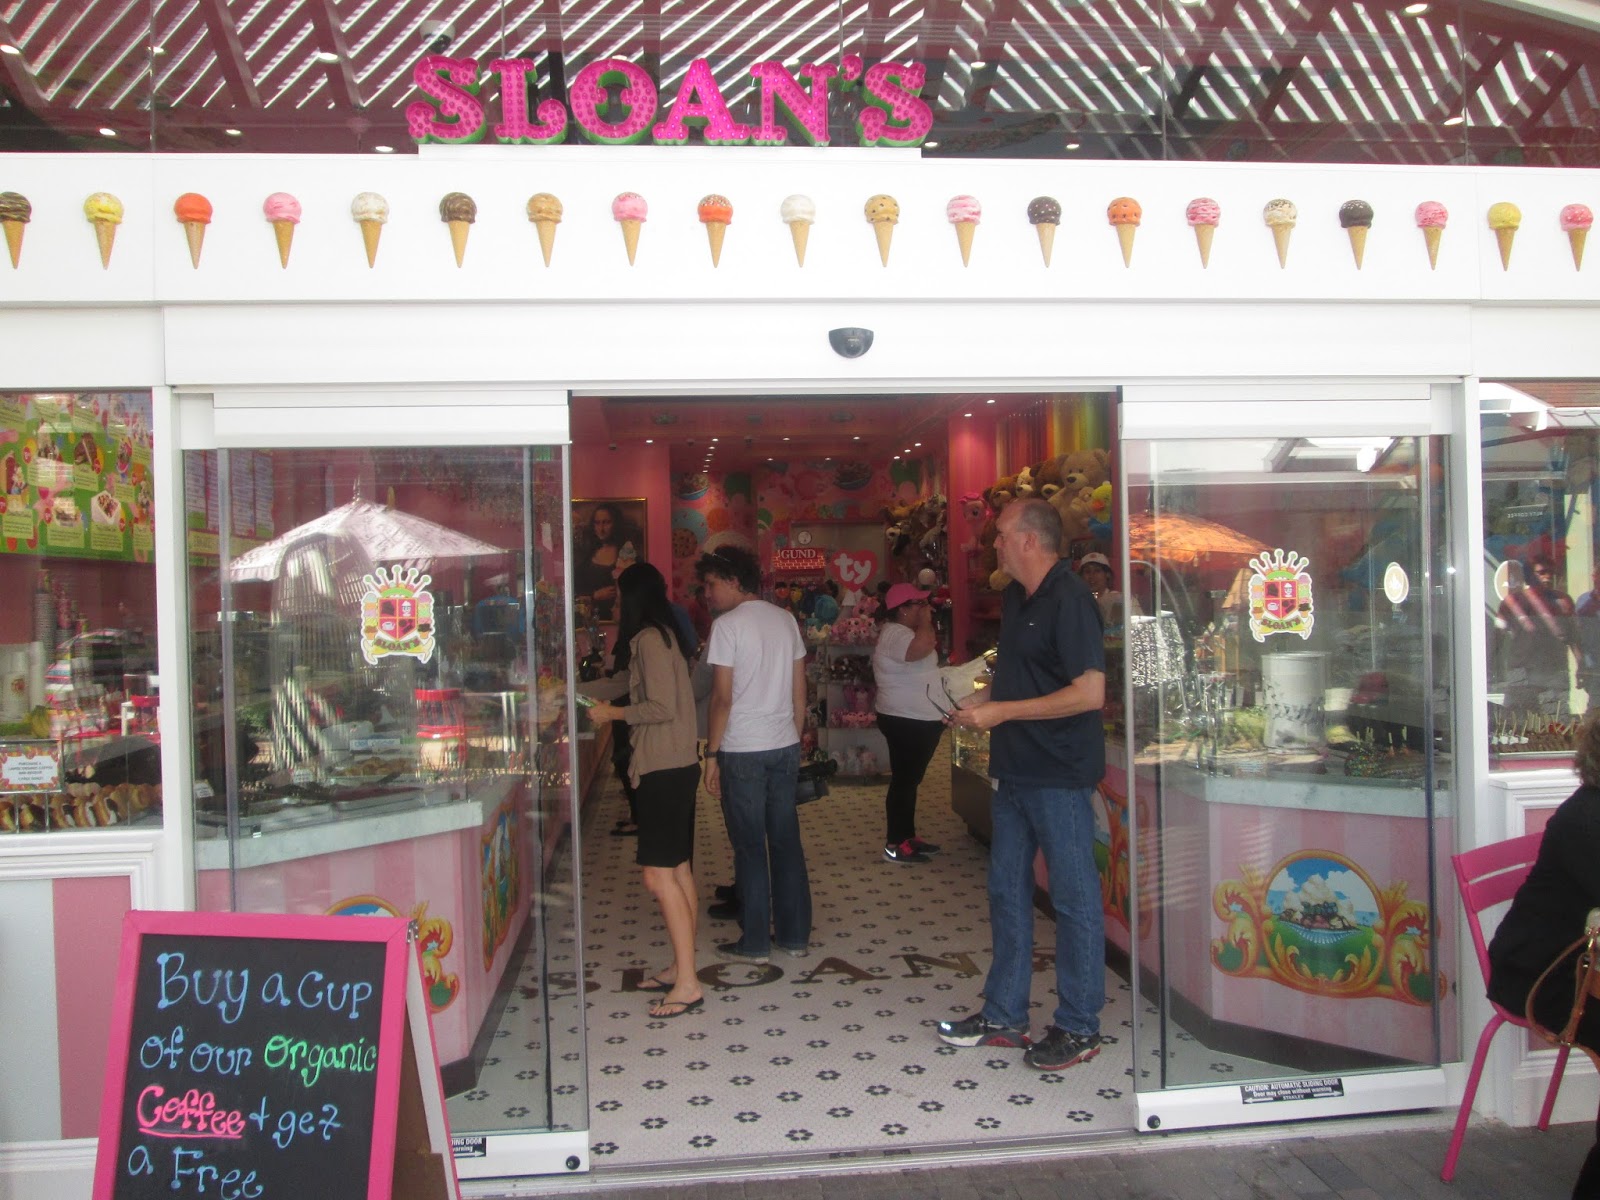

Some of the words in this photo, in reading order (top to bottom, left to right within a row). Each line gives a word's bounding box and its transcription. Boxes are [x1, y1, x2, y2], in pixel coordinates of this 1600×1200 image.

[405, 53, 934, 147] SLOAN'S
[780, 549, 817, 560] GUND
[834, 552, 872, 585] ty
[157, 952, 249, 1024] Buy
[261, 973, 291, 1007] a
[298, 971, 372, 1019] Cup
[1244, 1084, 1269, 1093] CAUTION:
[1270, 1081, 1302, 1091] AUTOMATIC
[1324, 1078, 1340, 1086] DOOR
[137, 1085, 246, 1134] Coffee
[272, 1104, 341, 1148] get
[128, 1145, 154, 1176] a
[171, 1146, 264, 1200] Free
